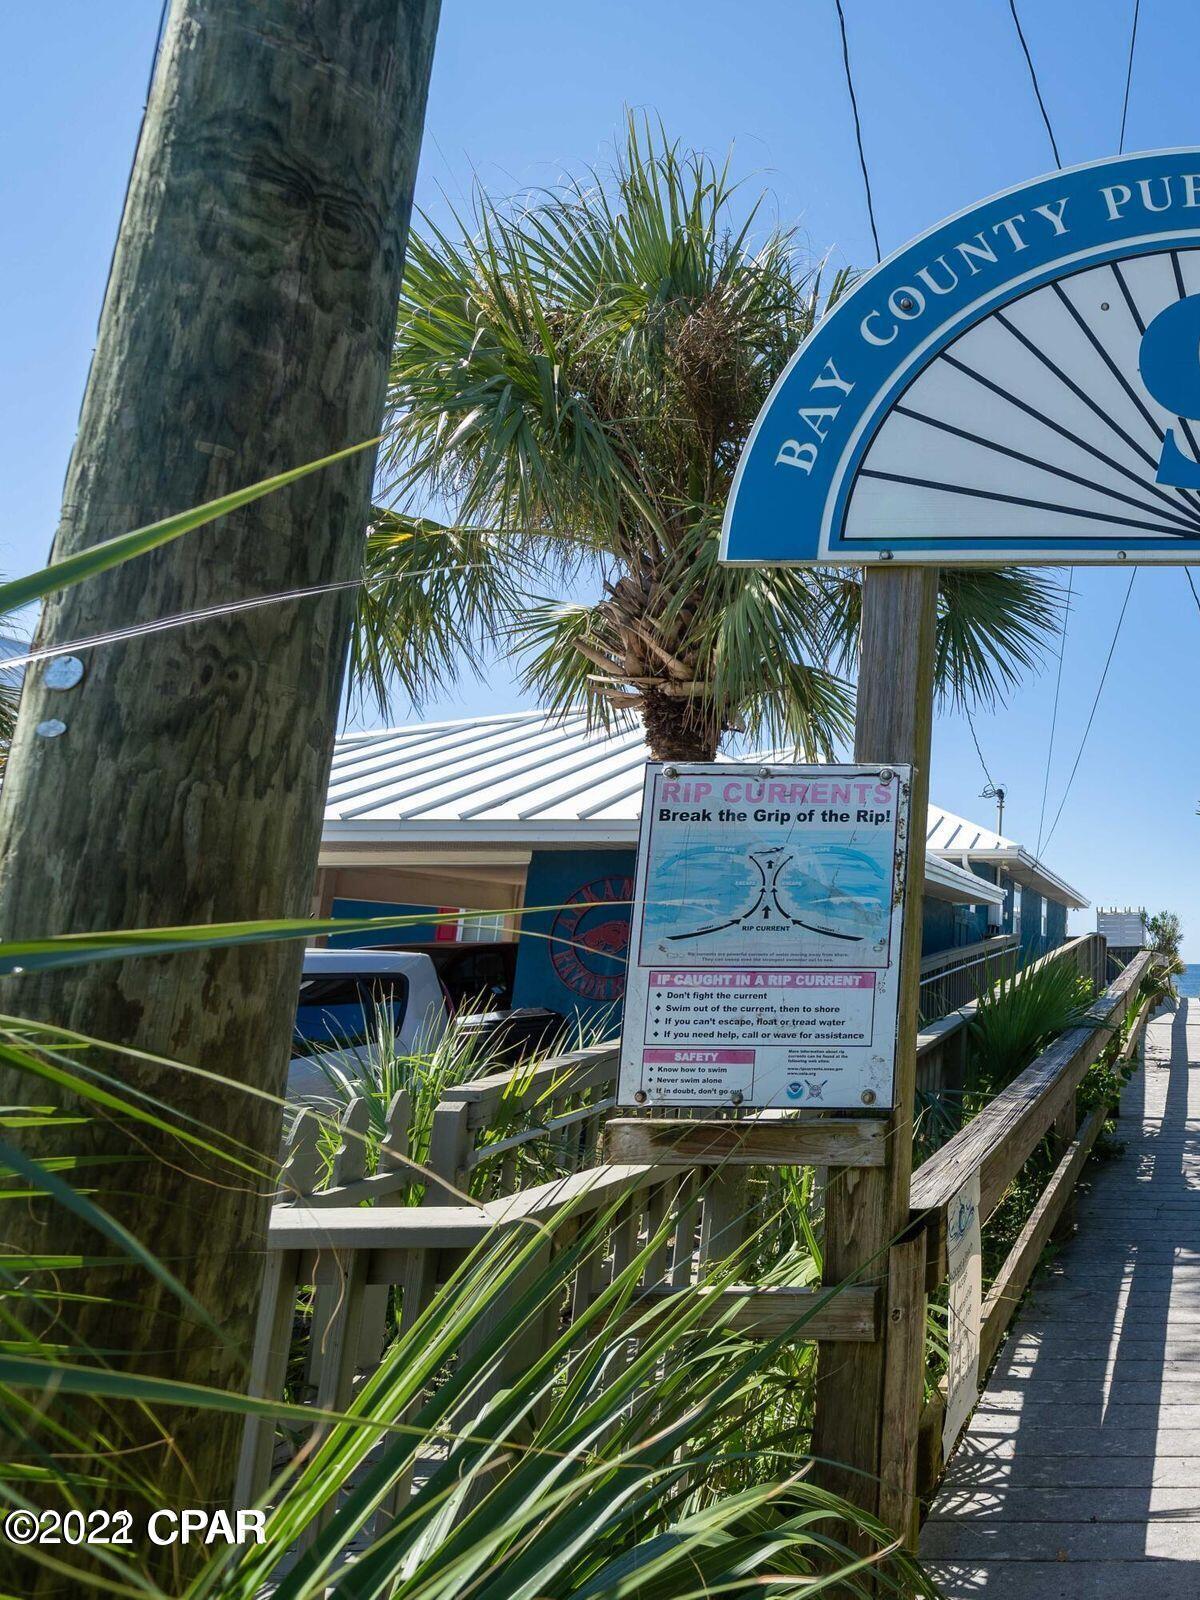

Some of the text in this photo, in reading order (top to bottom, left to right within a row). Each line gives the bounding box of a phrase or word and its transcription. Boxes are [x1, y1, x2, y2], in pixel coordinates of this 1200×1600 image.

[774, 359, 856, 476] BAY
[860, 197, 1070, 346] COUNTY
[662, 782, 892, 804] RIP CURRENTS
[659, 808, 891, 826] Break the Grip of the Rip!
[657, 974, 862, 986] IF CAUGHT IN A RIP CURRENT
[667, 991, 690, 999] Don't
[693, 992, 714, 1000] fight
[733, 992, 768, 1000] current
[665, 1004, 691, 1012] Swim
[711, 1004, 720, 1012] of
[740, 1005, 777, 1013] current,
[779, 1005, 800, 1013] then
[674, 1019, 691, 1027] you
[718, 1018, 754, 1027] escape,
[756, 1018, 778, 1026] float
[792, 1018, 816, 1026] tread
[663, 1030, 671, 1038] If
[717, 1031, 739, 1040] help,
[799, 1031, 813, 1039] for
[814, 1031, 865, 1039] assistance
[674, 1052, 719, 1061] SAFETY
